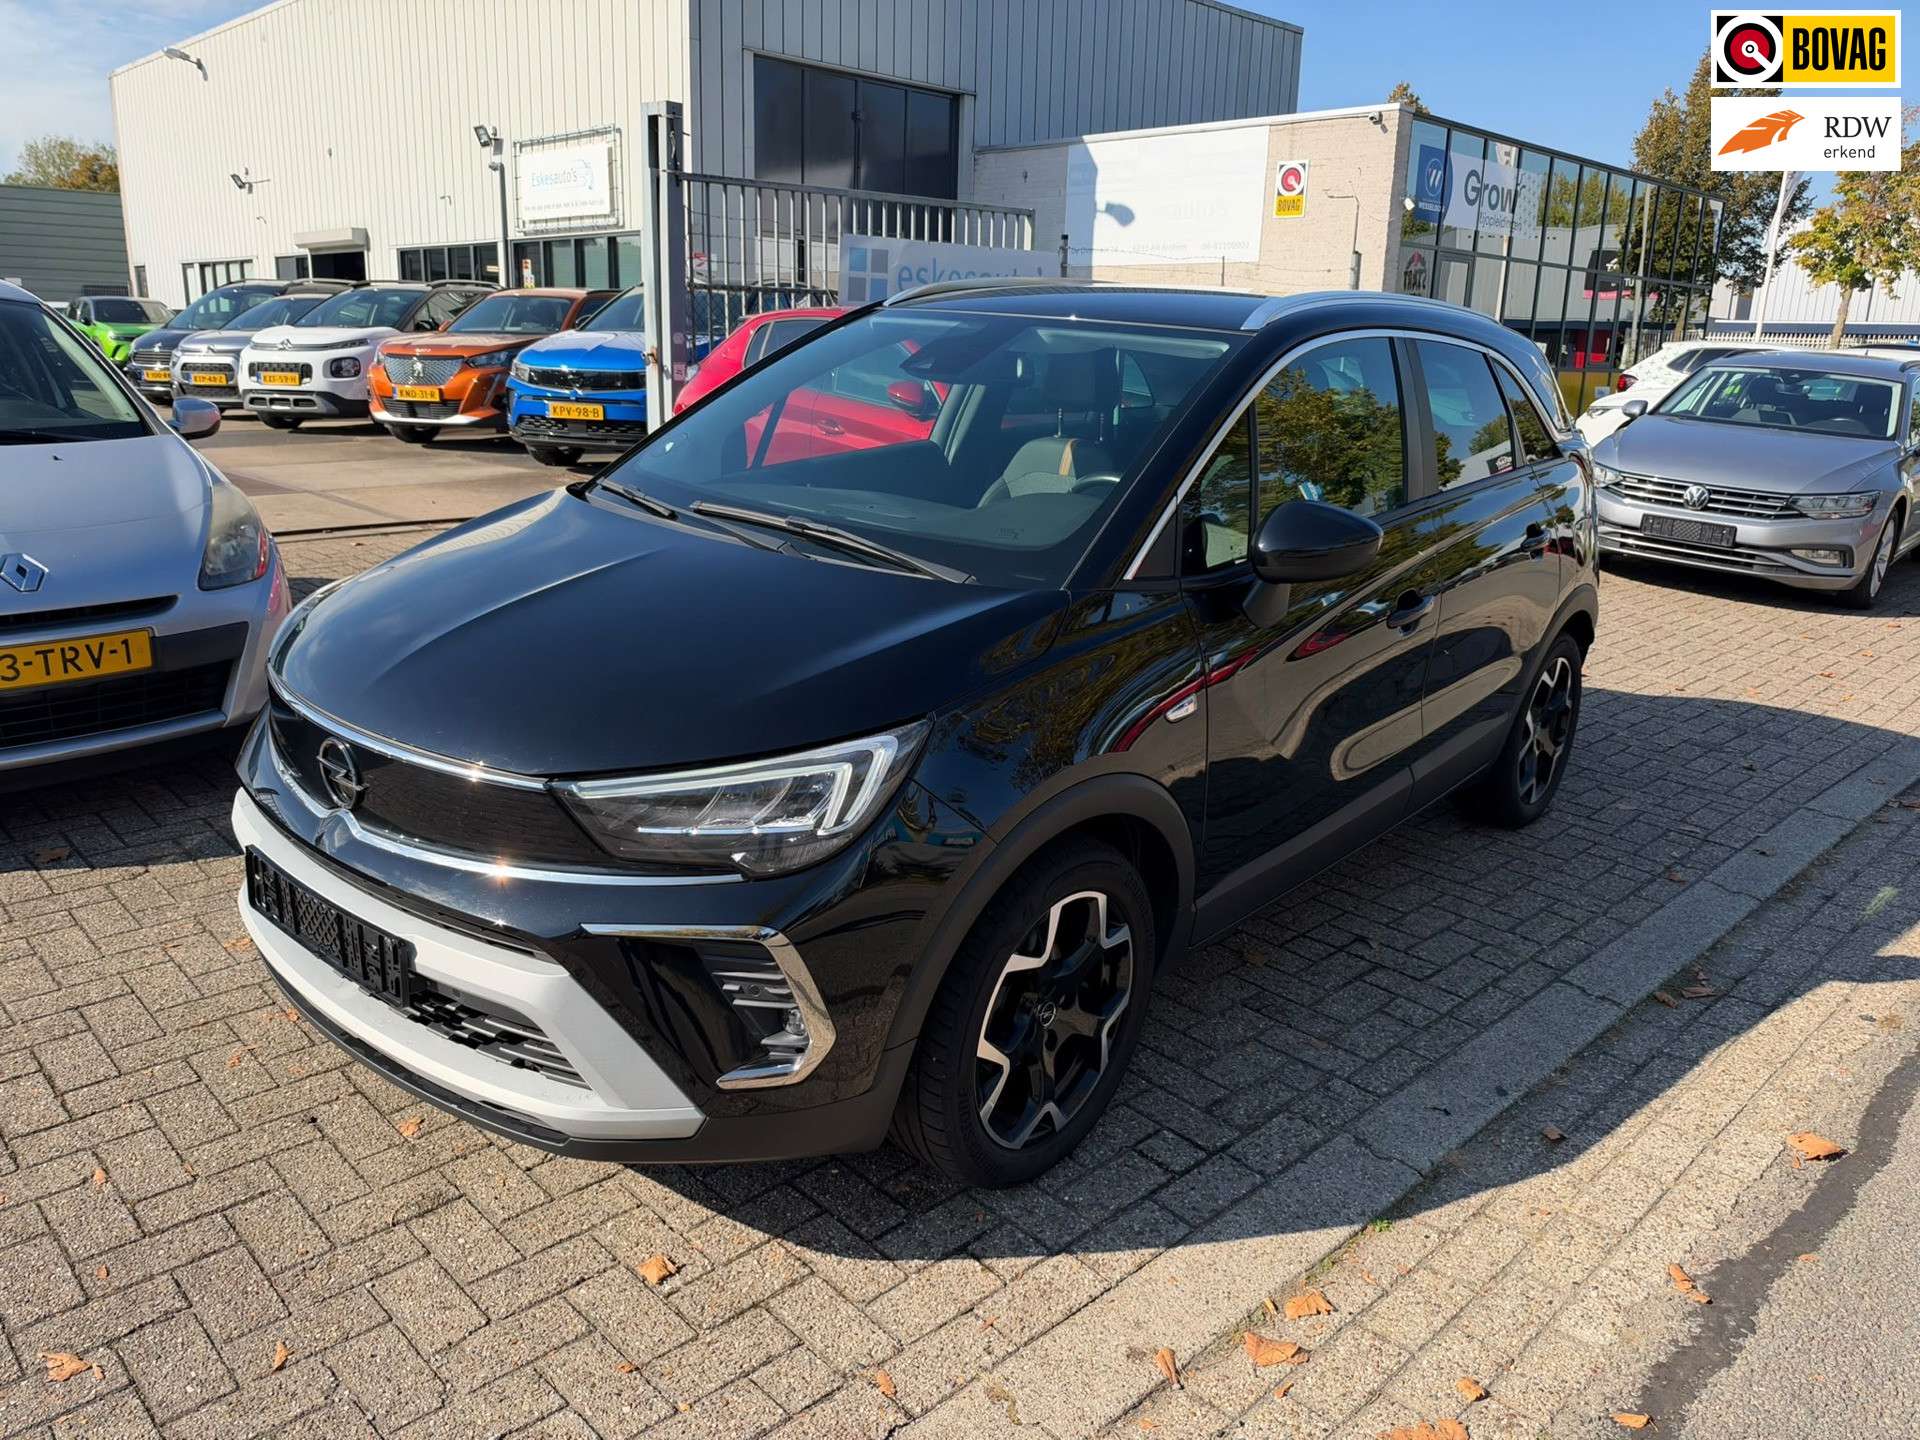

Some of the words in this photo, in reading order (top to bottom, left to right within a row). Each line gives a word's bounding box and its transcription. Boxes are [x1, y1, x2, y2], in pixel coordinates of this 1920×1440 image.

[1278, 199, 1301, 212] BOVAG
[552, 405, 600, 418] KPV-98-B
[0, 638, 132, 682] 3-TRV-1
